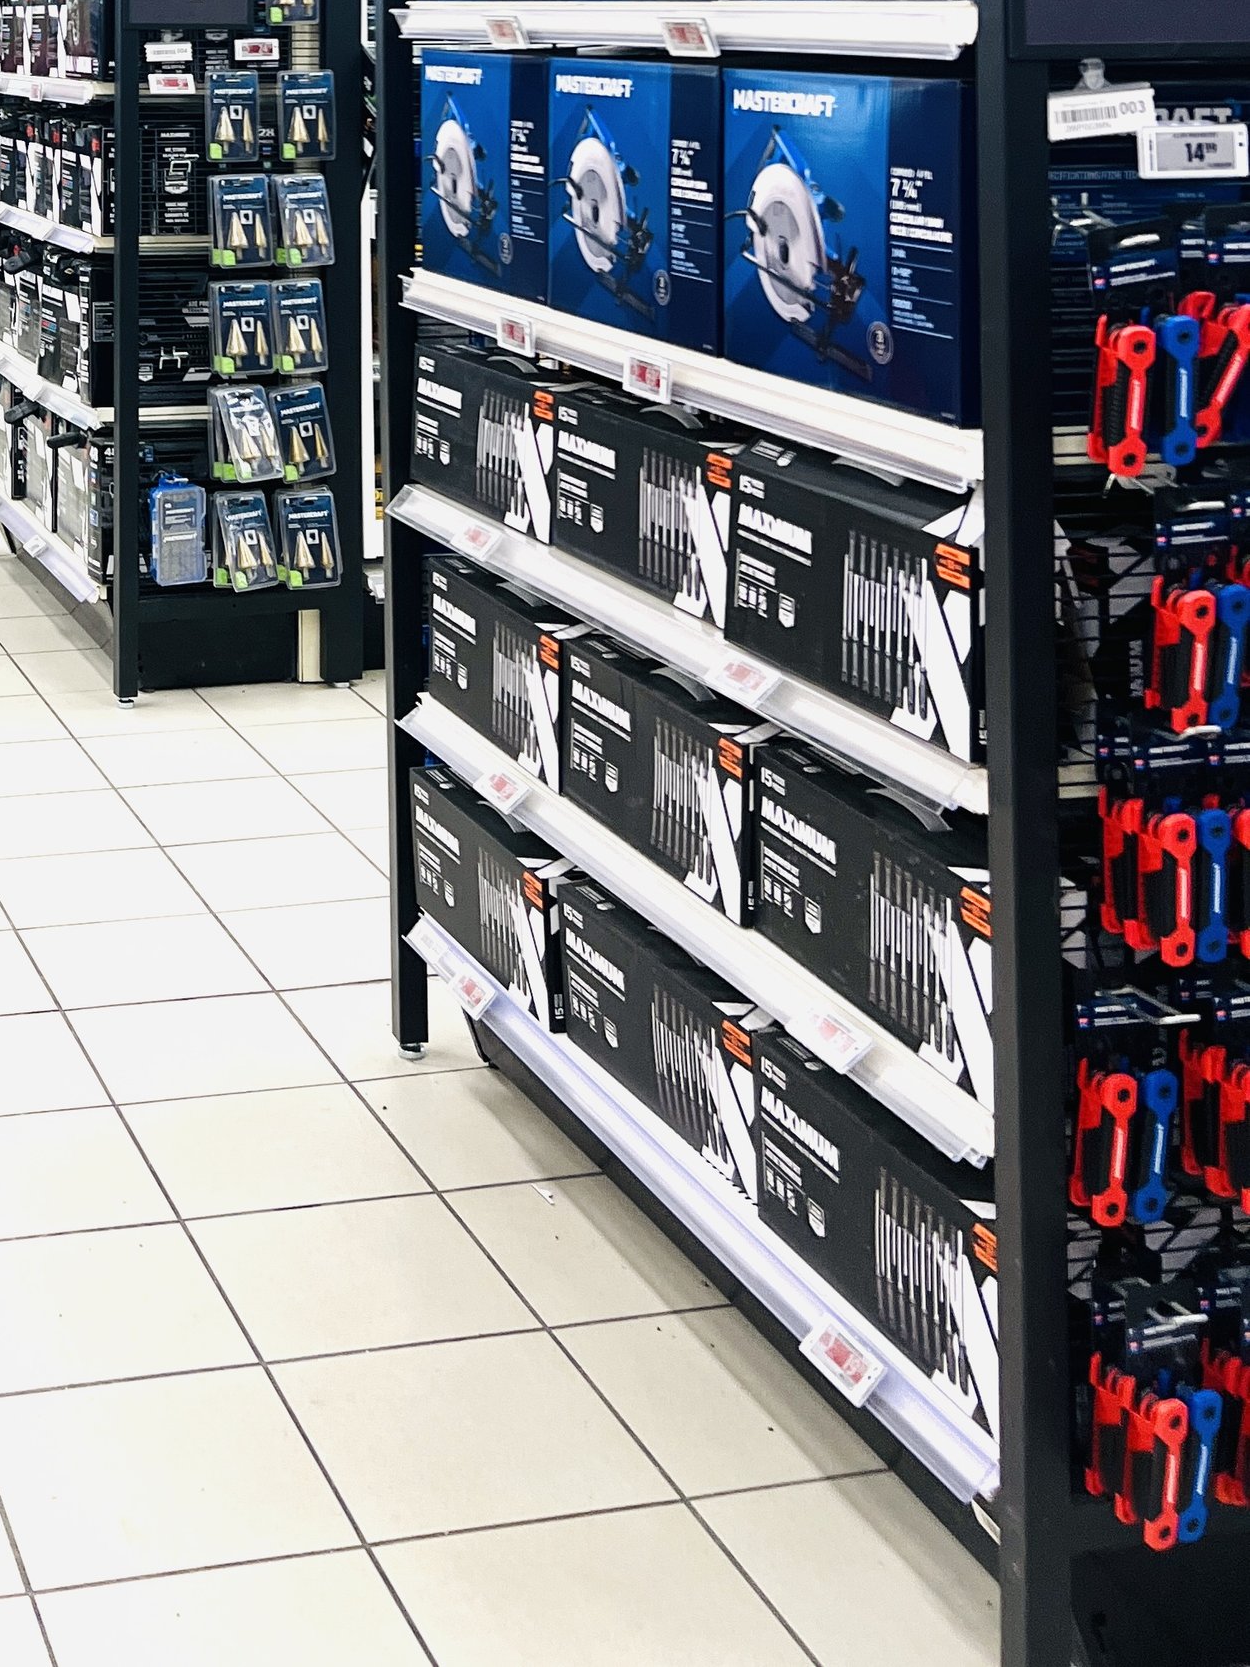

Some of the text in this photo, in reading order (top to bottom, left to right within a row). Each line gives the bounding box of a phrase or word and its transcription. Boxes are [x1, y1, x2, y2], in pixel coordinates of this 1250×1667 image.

[733, 88, 837, 118] MASTERCRAFT
[1120, 100, 1147, 116] 003
[761, 766, 773, 788] 15
[760, 795, 837, 866] MAXIMUM
[760, 1055, 774, 1079] 15
[760, 1086, 840, 1173] MAXIMUM
